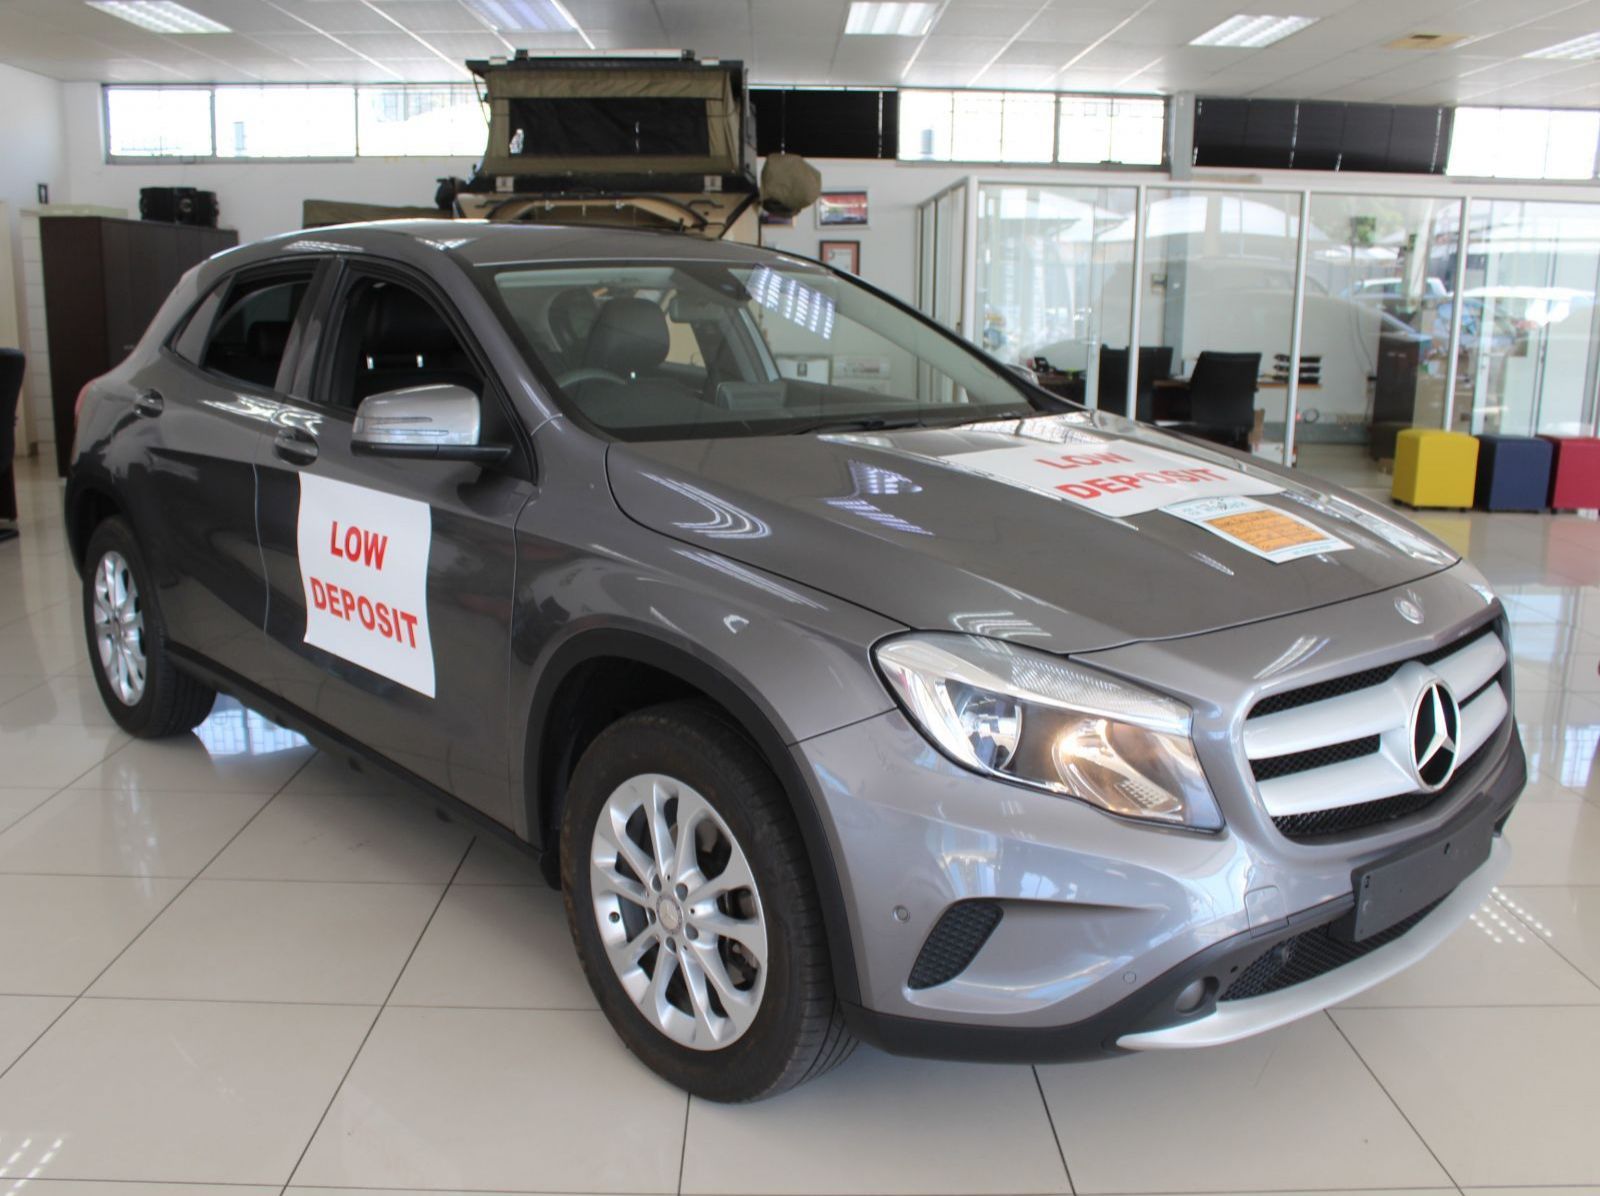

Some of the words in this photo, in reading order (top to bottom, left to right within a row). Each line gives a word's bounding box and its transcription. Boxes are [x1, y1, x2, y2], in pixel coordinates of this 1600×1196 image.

[1036, 452, 1133, 470] LOW
[1056, 467, 1228, 499] DEPOSIT
[330, 521, 389, 572] LOW
[309, 576, 418, 649] DEPOSIT
